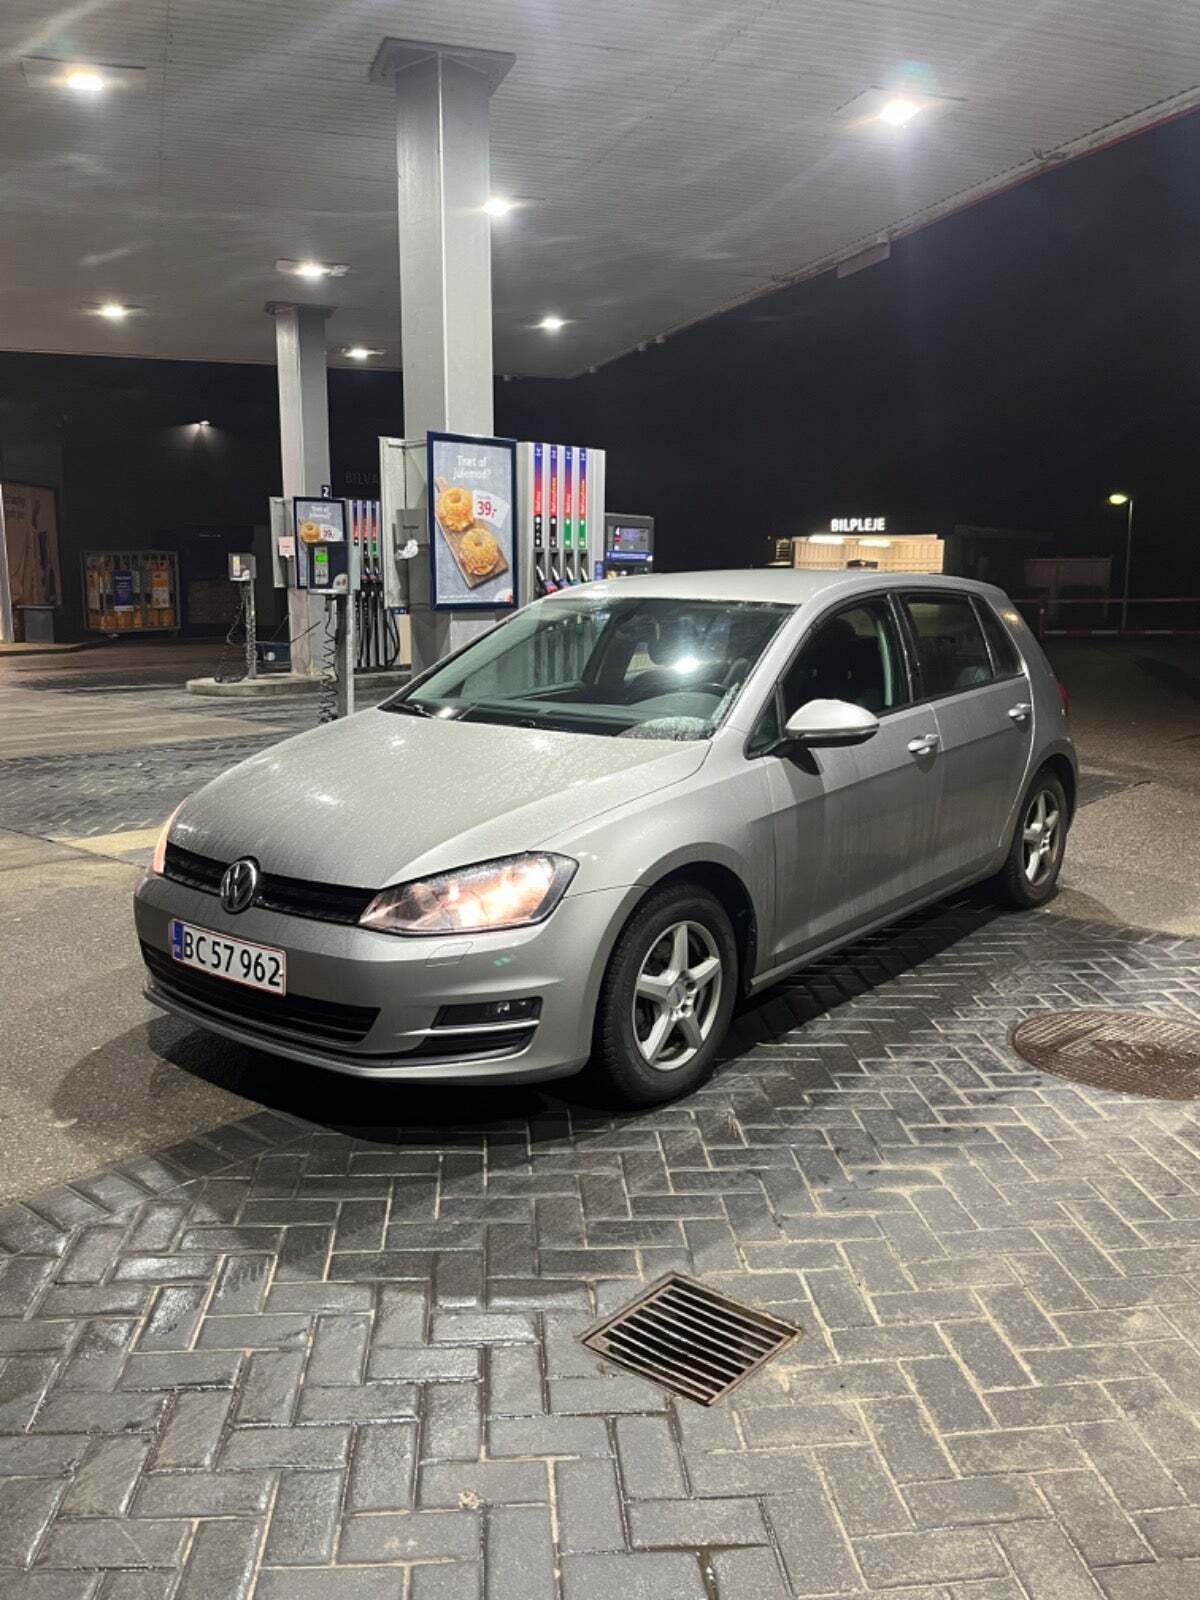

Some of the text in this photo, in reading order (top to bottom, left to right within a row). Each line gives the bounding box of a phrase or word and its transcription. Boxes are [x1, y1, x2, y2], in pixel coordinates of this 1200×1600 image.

[322, 486, 329, 497] 2
[831, 517, 886, 532] BILPLEJE
[211, 942, 235, 973] 57
[240, 949, 281, 987] 962
